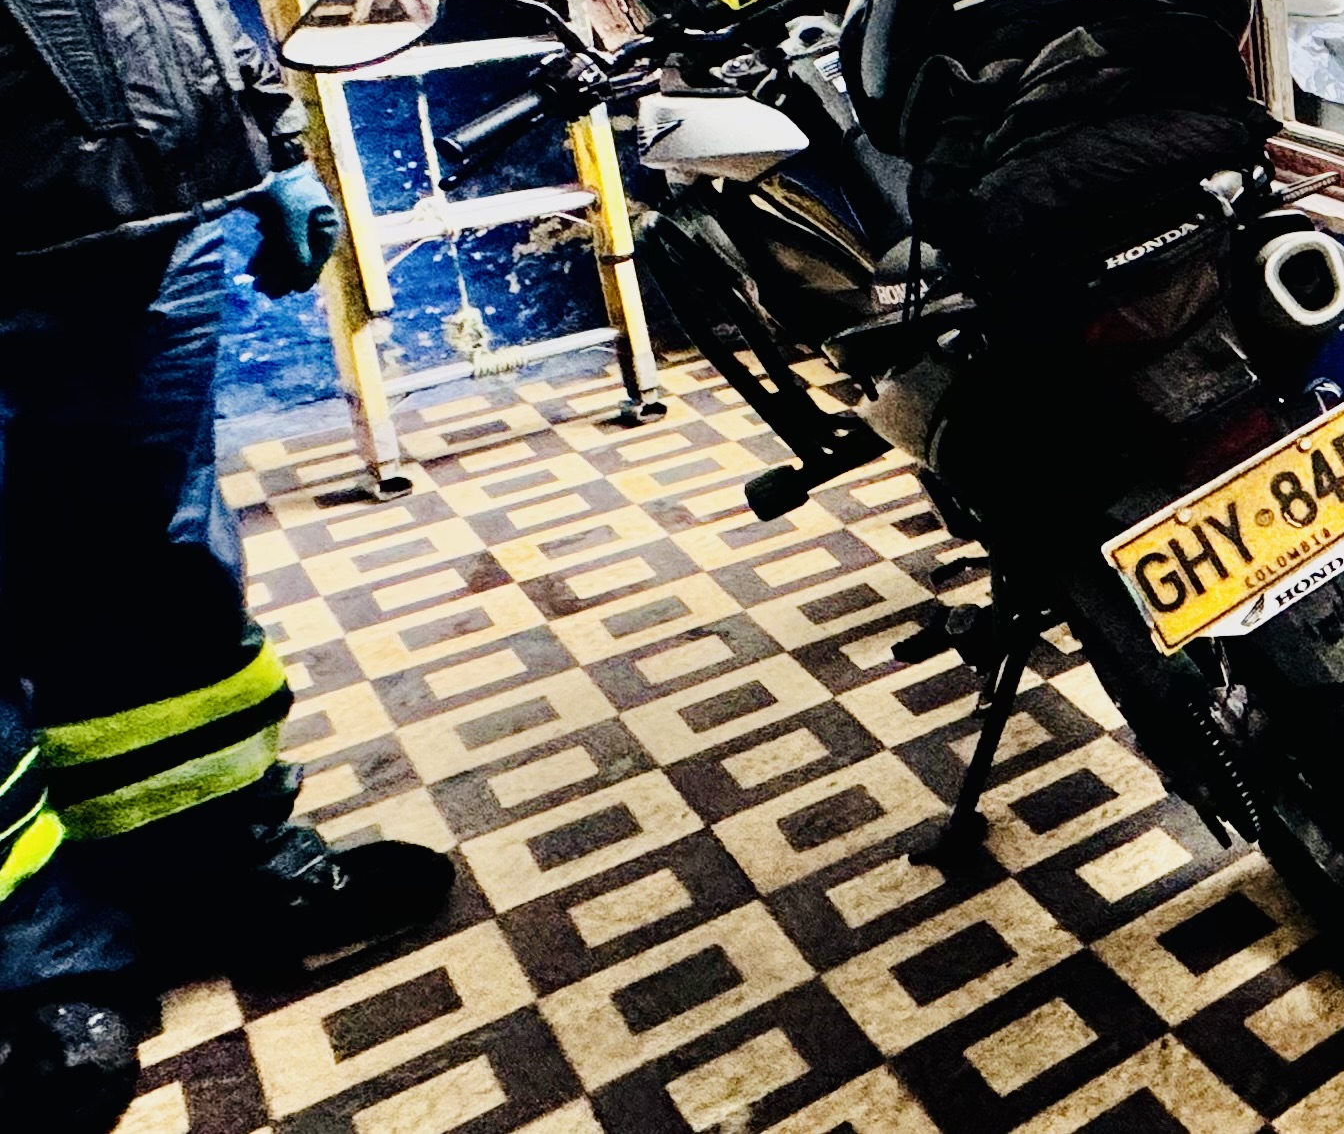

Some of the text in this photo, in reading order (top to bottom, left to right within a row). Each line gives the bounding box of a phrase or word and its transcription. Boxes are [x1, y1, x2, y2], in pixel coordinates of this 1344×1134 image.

[1104, 222, 1200, 270] HONDA
[874, 277, 931, 305] HONA
[1134, 501, 1255, 614] GHY
[1244, 527, 1332, 589] COLOMBIA
